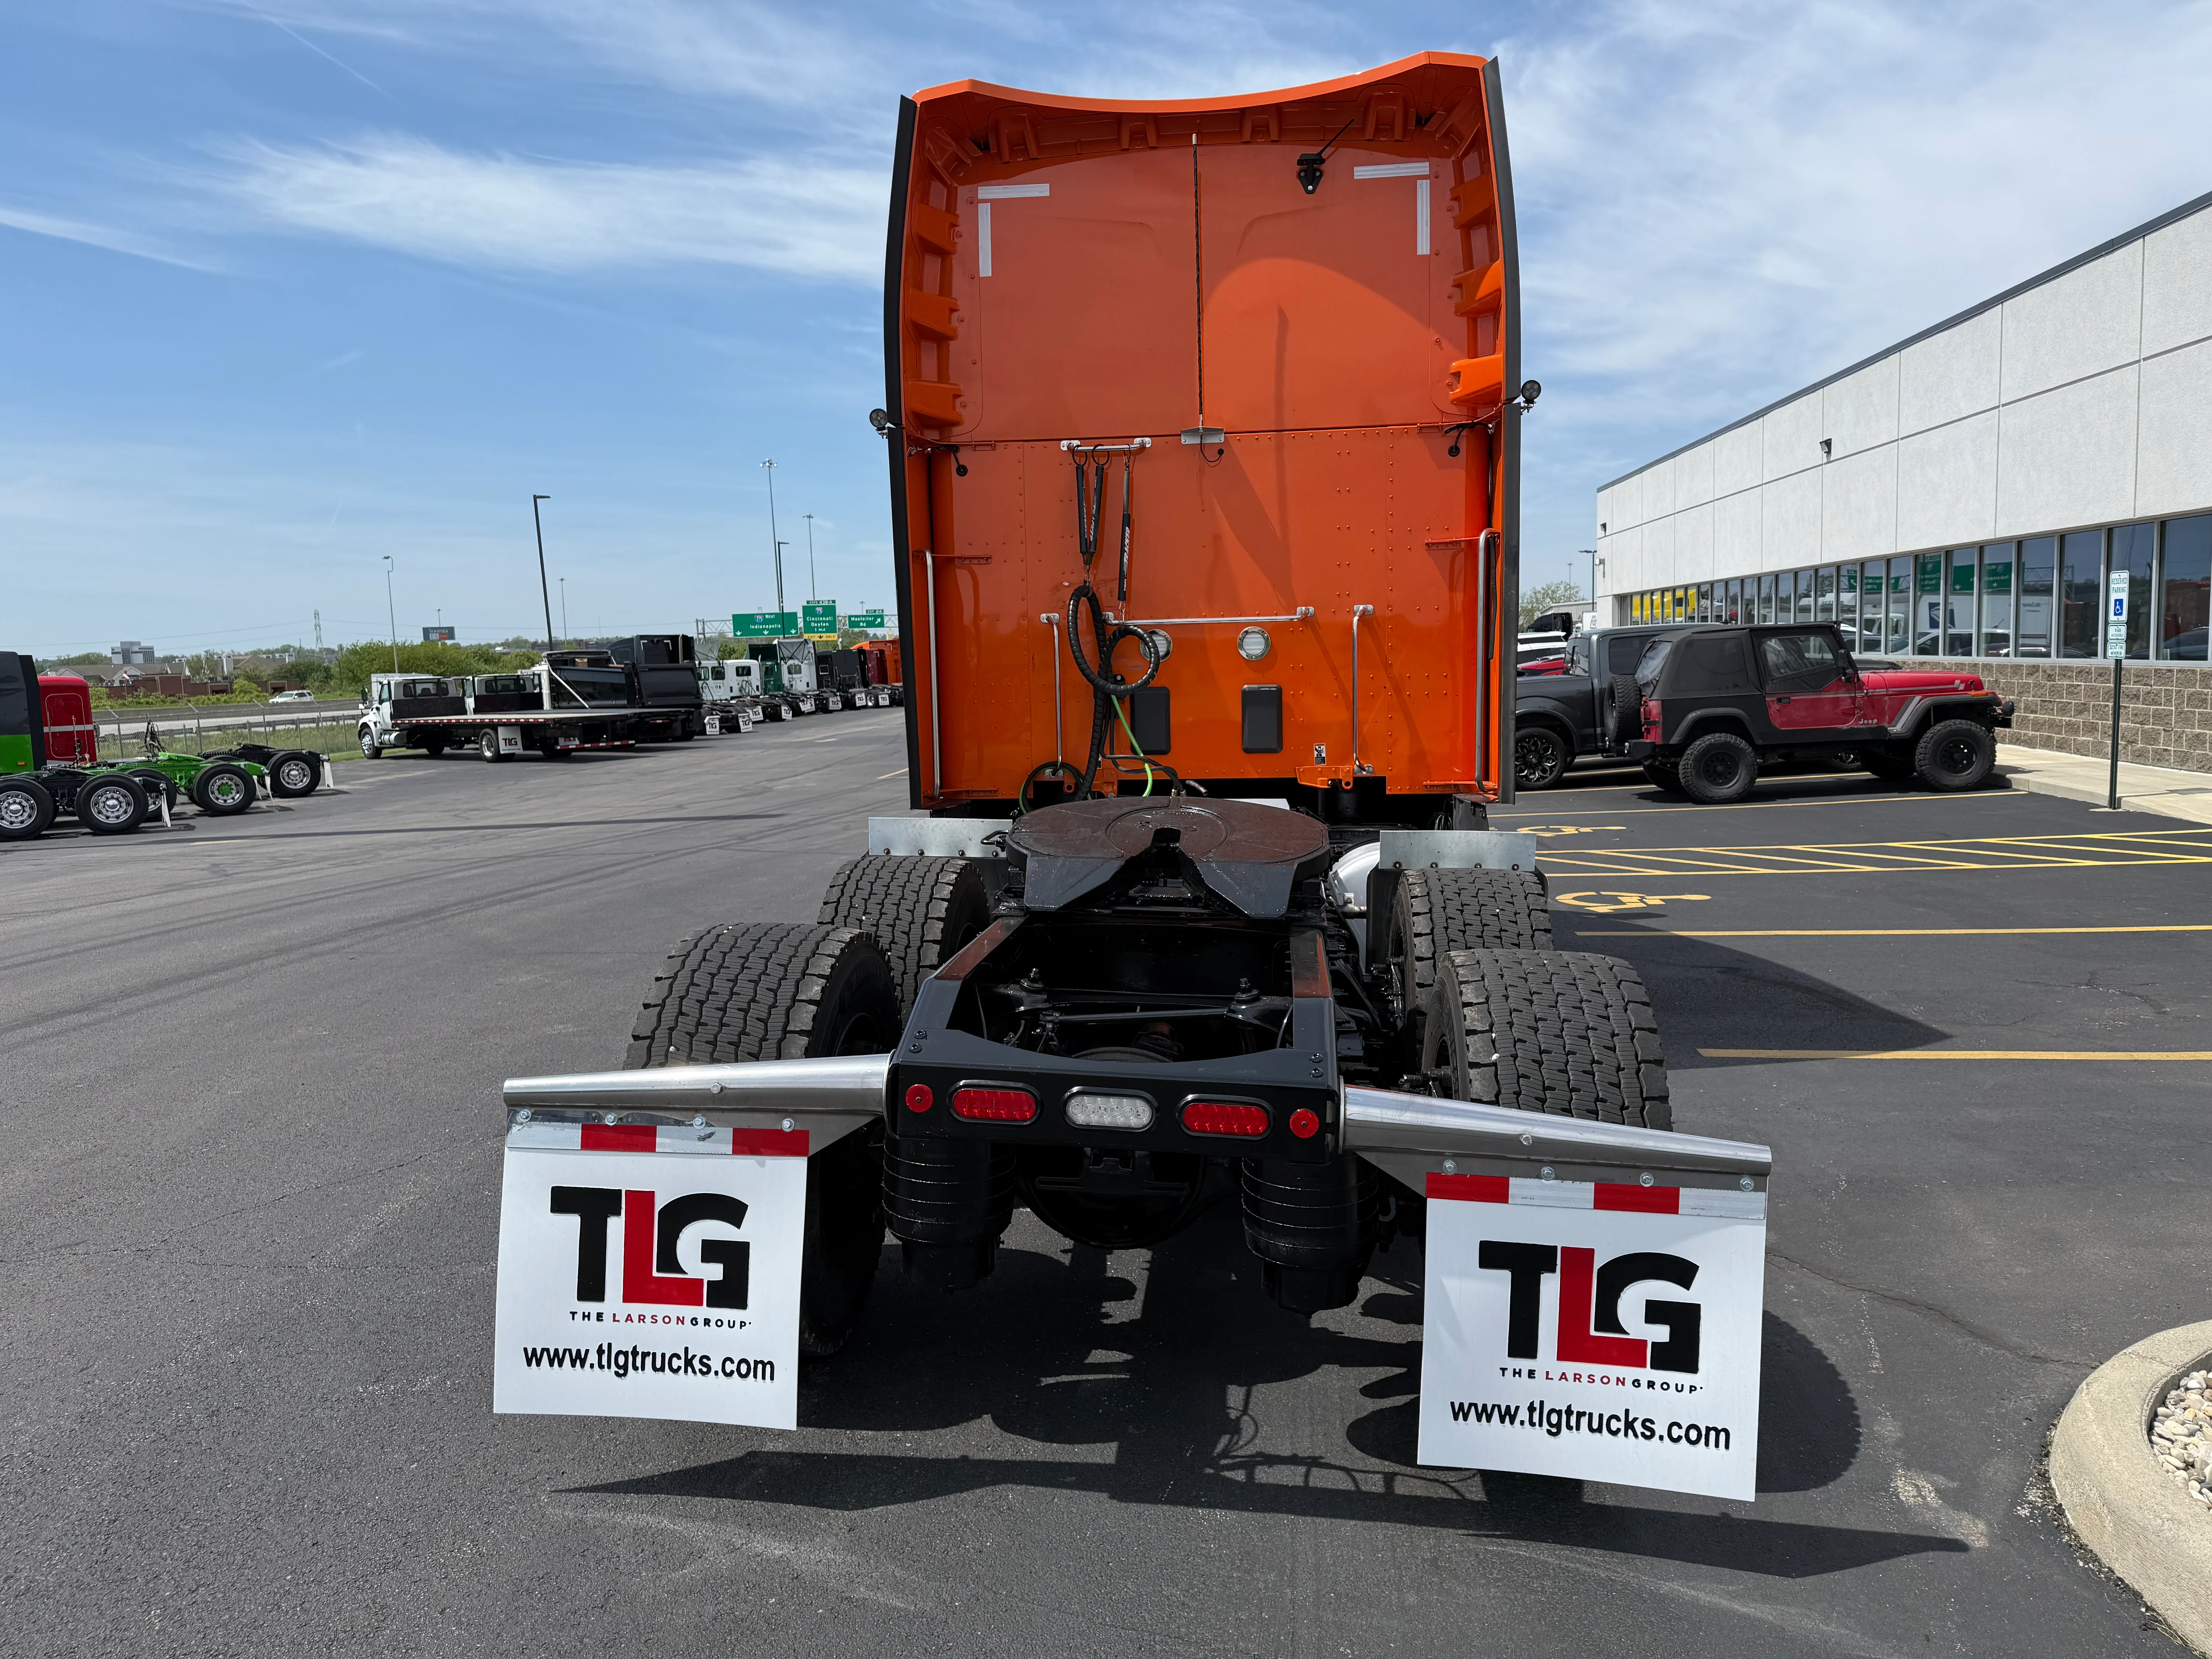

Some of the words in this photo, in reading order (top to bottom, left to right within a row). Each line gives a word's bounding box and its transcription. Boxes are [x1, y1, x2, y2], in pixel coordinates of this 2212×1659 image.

[502, 738, 518, 746] TLG
[550, 1186, 750, 1310] TLG
[569, 1311, 604, 1322] THE
[1479, 1240, 1701, 1374] TLG
[524, 1342, 775, 1381] www.tlgtrucks.com
[1499, 1367, 1536, 1379] THE
[1450, 1400, 1731, 1450] www.tlgtrucks.com
